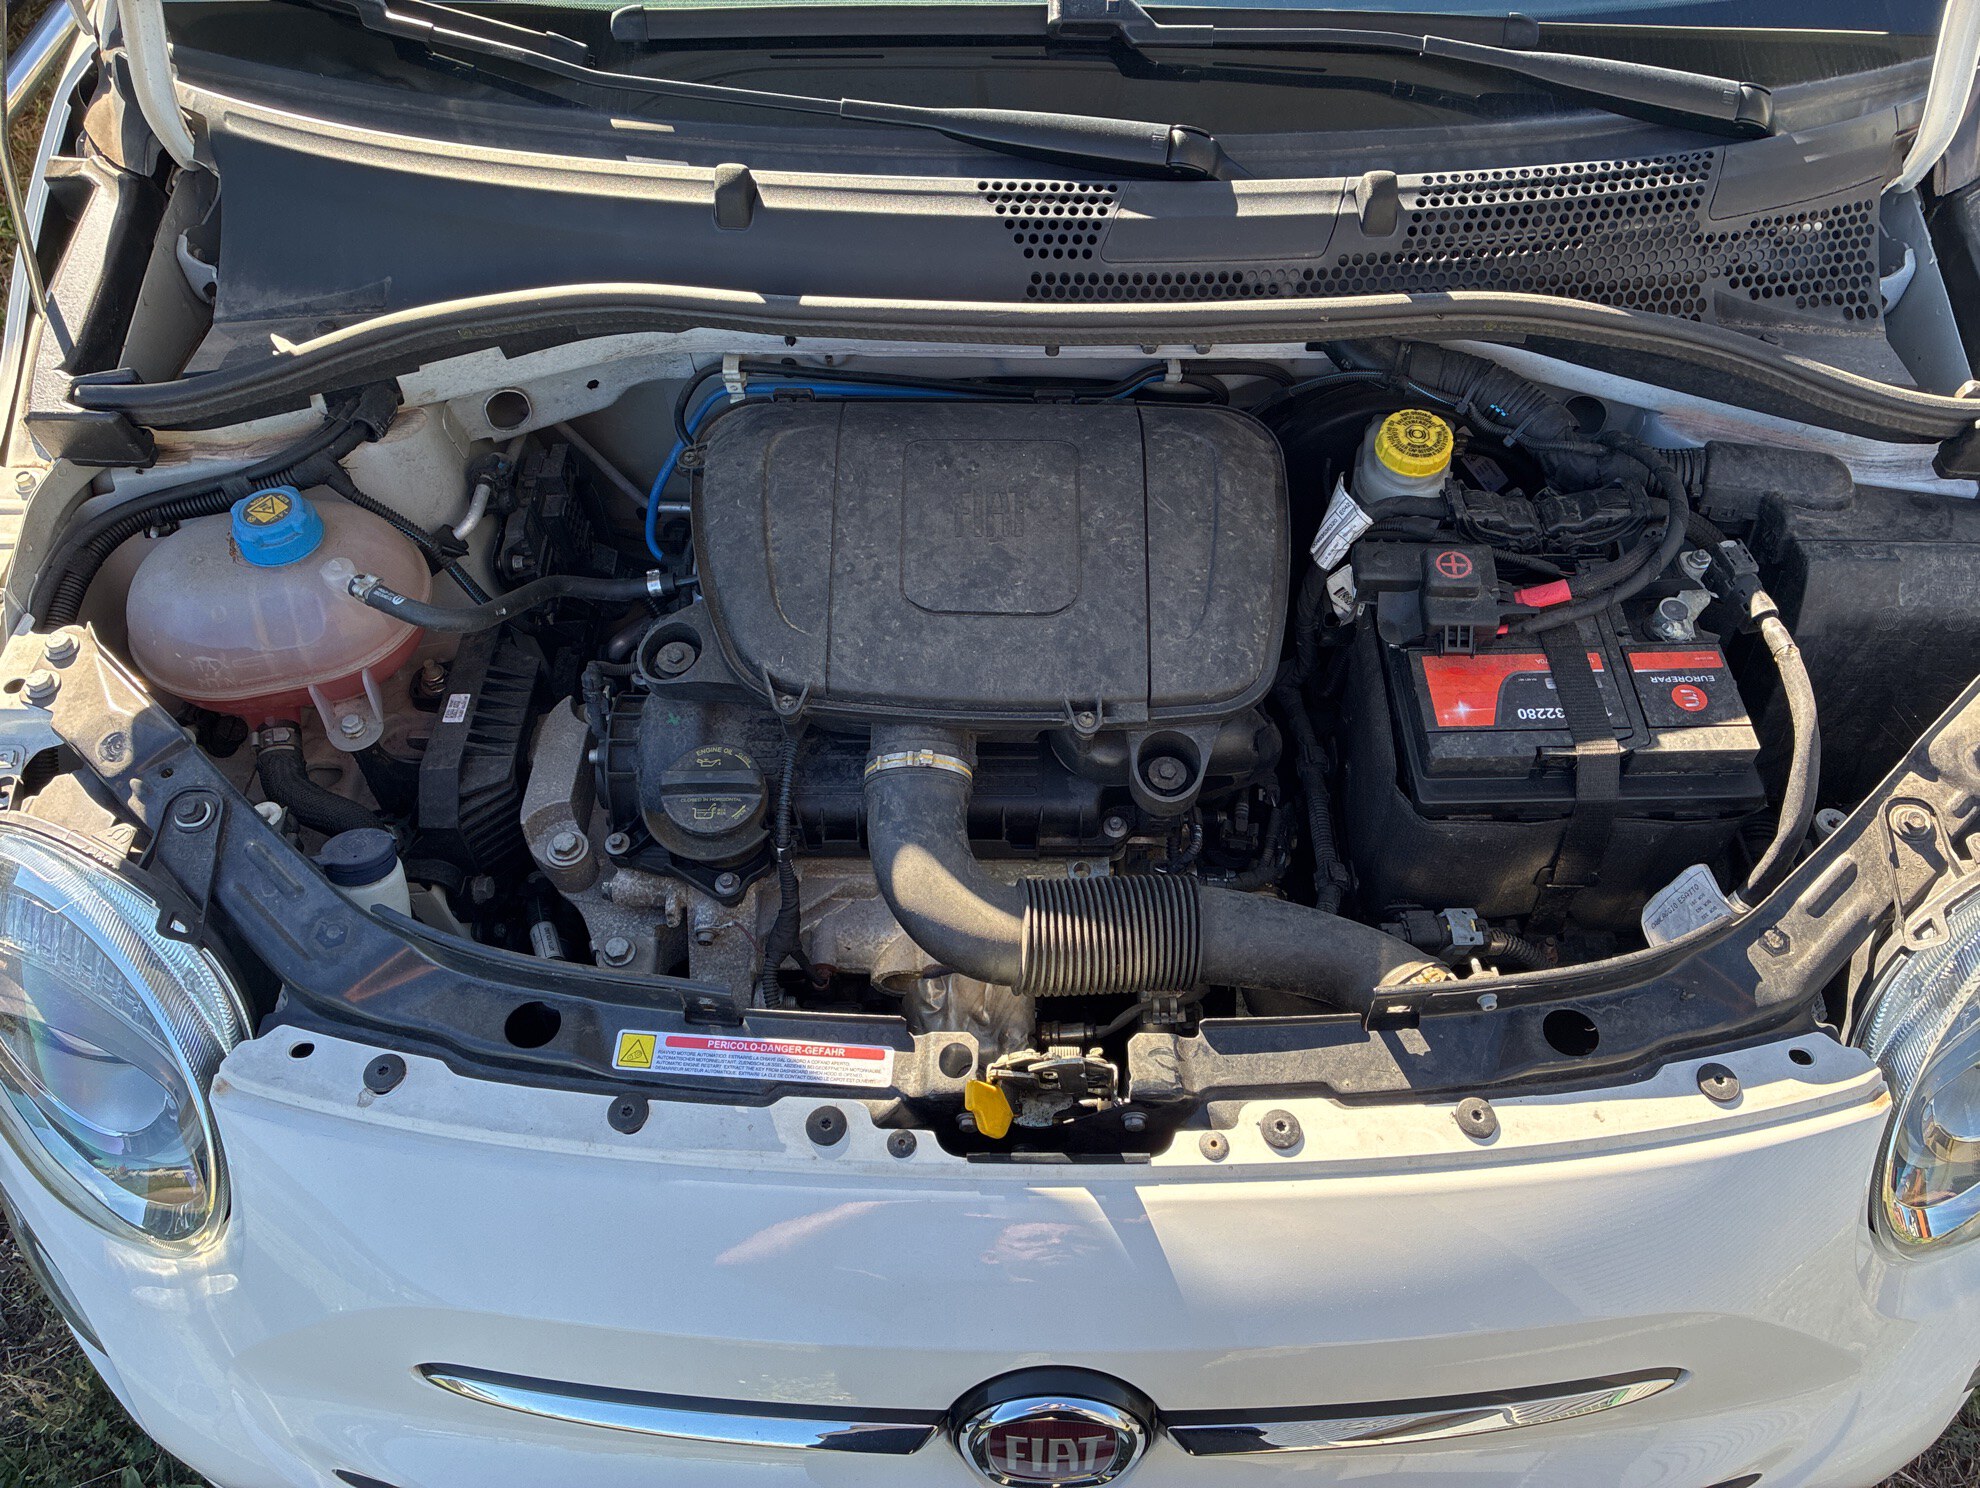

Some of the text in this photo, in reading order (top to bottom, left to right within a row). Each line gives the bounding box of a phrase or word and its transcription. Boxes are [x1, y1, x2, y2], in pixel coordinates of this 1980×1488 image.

[954, 490, 1030, 537] FIAT
[1650, 674, 1715, 684] EUROREPAR
[696, 747, 734, 757] ENGINE OIL
[1678, 883, 1700, 905] ESATTO
[707, 1039, 846, 1057] PERICOLO-DANGER-GEFAHR
[1006, 1434, 1107, 1473] FIAT
